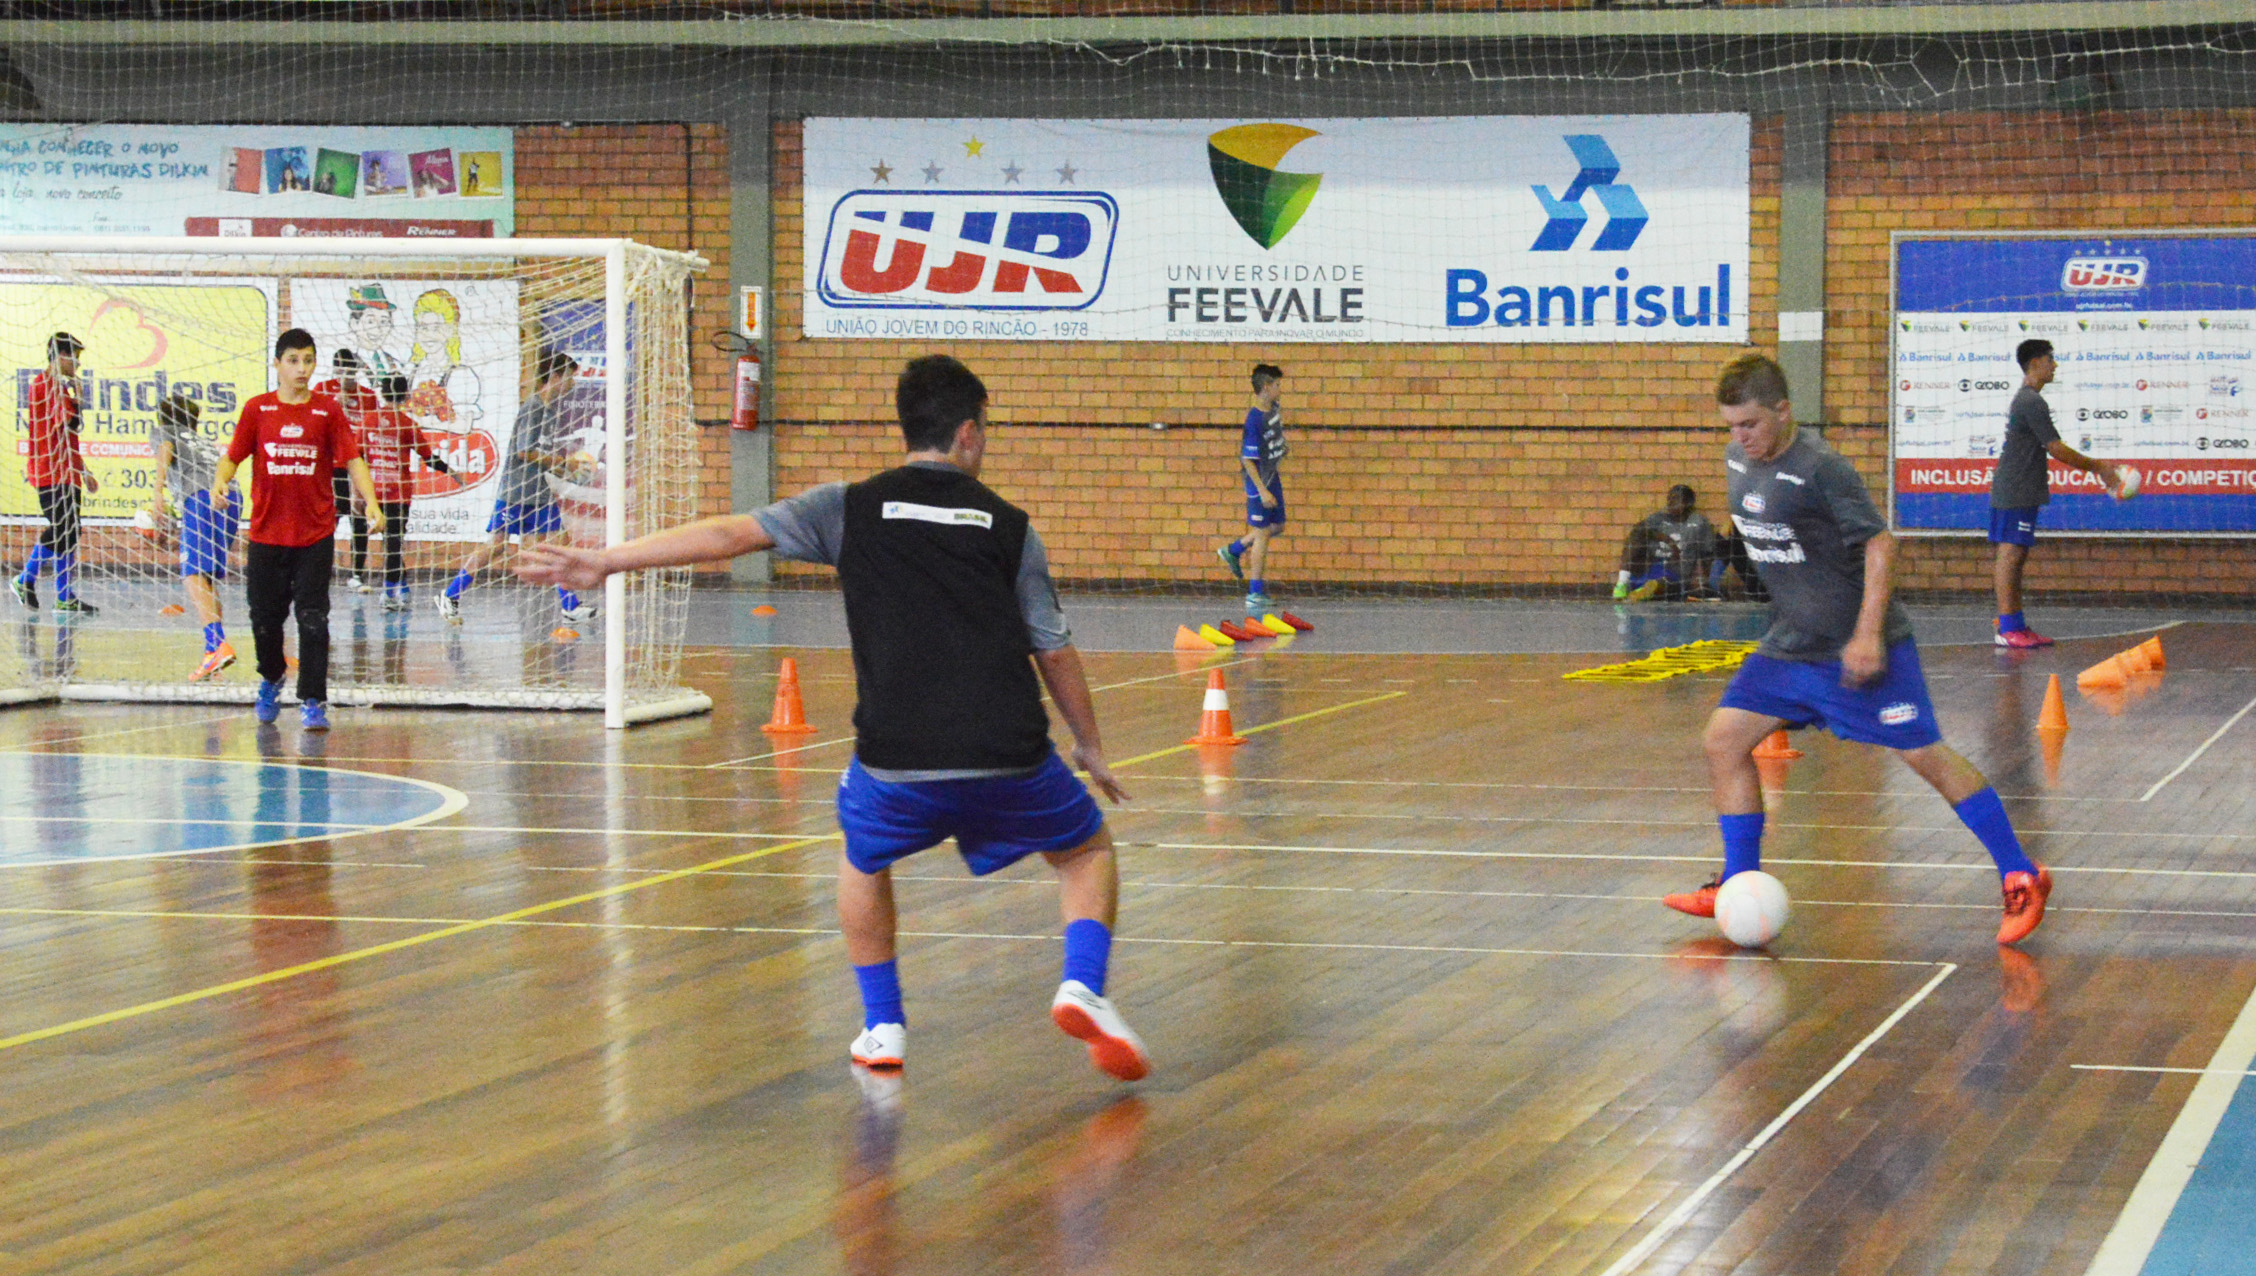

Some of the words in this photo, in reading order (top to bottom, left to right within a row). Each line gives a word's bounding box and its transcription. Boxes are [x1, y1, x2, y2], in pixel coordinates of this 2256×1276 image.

[121, 142, 132, 153] O
[138, 142, 180, 158] NOVO
[44, 160, 65, 175] DE
[72, 162, 152, 179] PINTURAS
[159, 162, 209, 178] DILKIN
[77, 185, 123, 200] conceito
[839, 211, 1092, 294] UJR
[1168, 264, 1364, 281] UNIVERSIDADE
[2069, 263, 2140, 286] UJR
[1446, 264, 1730, 328] Banrisul
[1168, 287, 1364, 323] FEEVALE
[826, 317, 877, 335] UNIÃO
[882, 319, 938, 335] JOVEM
[944, 320, 967, 335] DO
[973, 317, 1037, 336] RINCÃO
[1052, 321, 1088, 336] 1978
[1909, 352, 1952, 361] Banrisul
[1968, 352, 2011, 361] Banrisul
[2086, 351, 2130, 361] Banrisul
[2147, 351, 2190, 361] Banrisul
[2207, 350, 2251, 360] Banrisul
[1975, 380, 2010, 390] GLOBO
[2093, 409, 2129, 419] GLOBO
[2213, 438, 2249, 449] GLOBO
[440, 507, 469, 520] vida
